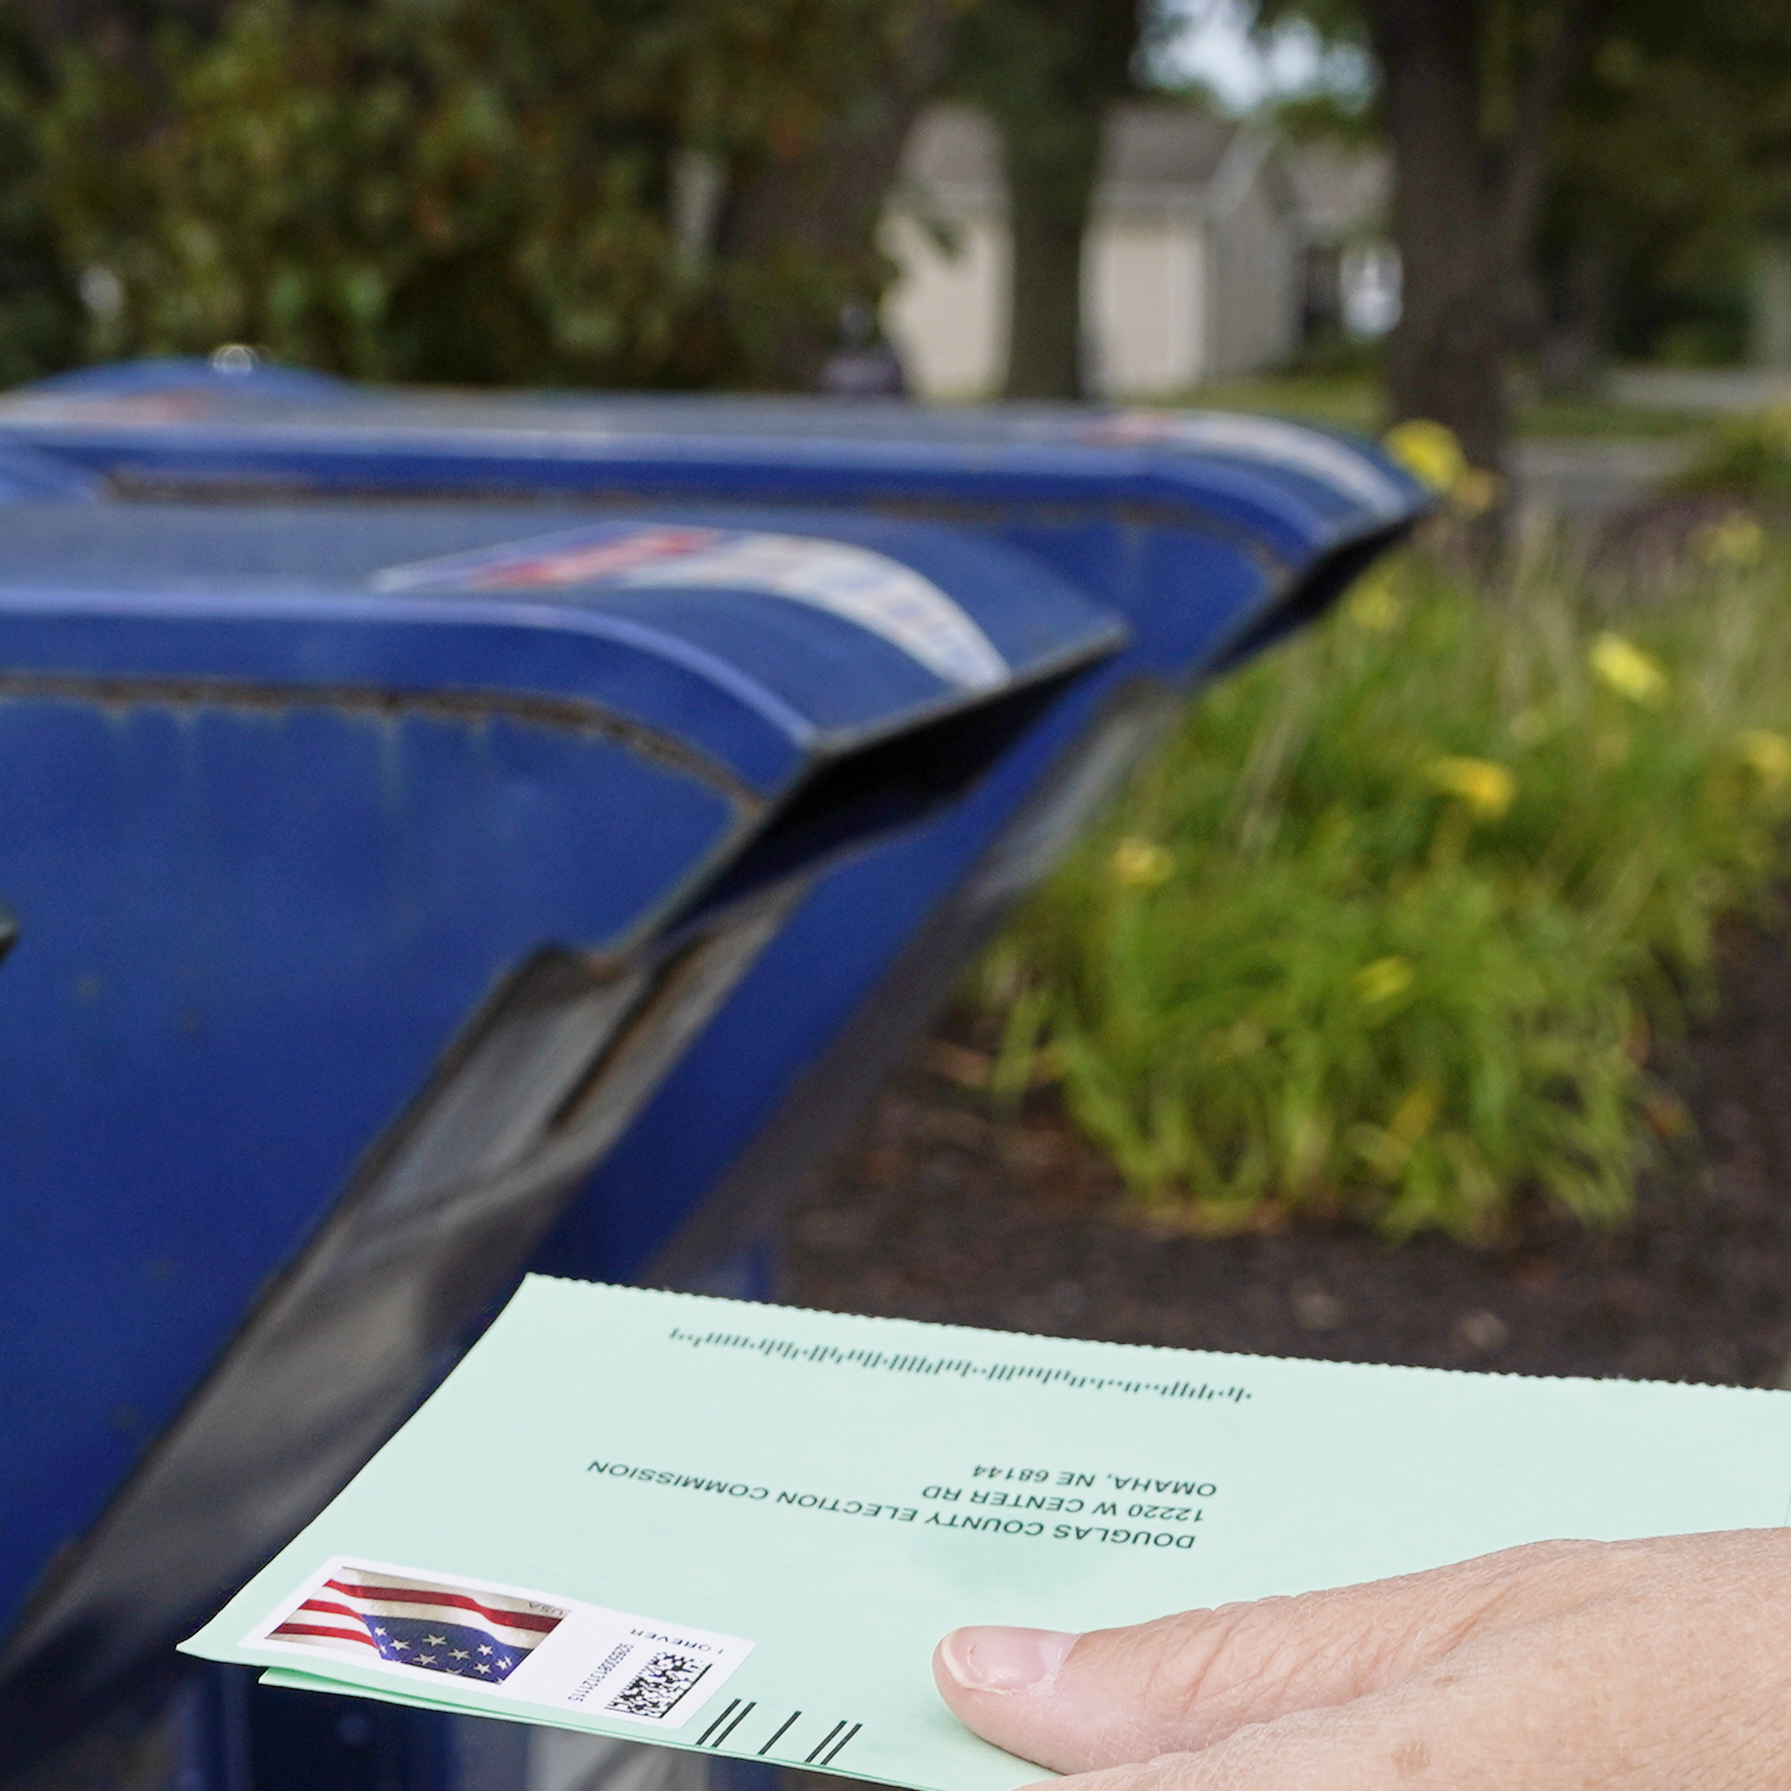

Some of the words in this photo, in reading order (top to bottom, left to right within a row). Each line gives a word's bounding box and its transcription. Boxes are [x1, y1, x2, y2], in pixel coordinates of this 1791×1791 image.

[586, 1460, 770, 1501] COMMISSION
[972, 1464, 1051, 1484] 68144
[1055, 1471, 1097, 1488] NE
[921, 1485, 963, 1502] RD
[1106, 1473, 1218, 1498] OMAHA,
[775, 1490, 920, 1523] ELECTION
[969, 1490, 1085, 1514] CENTER
[1091, 1501, 1118, 1517] W
[1127, 1503, 1205, 1523] 12220
[923, 1511, 1045, 1537] COUNTY
[1052, 1523, 1198, 1550] DOUGLAS
[528, 1601, 564, 1616] USA
